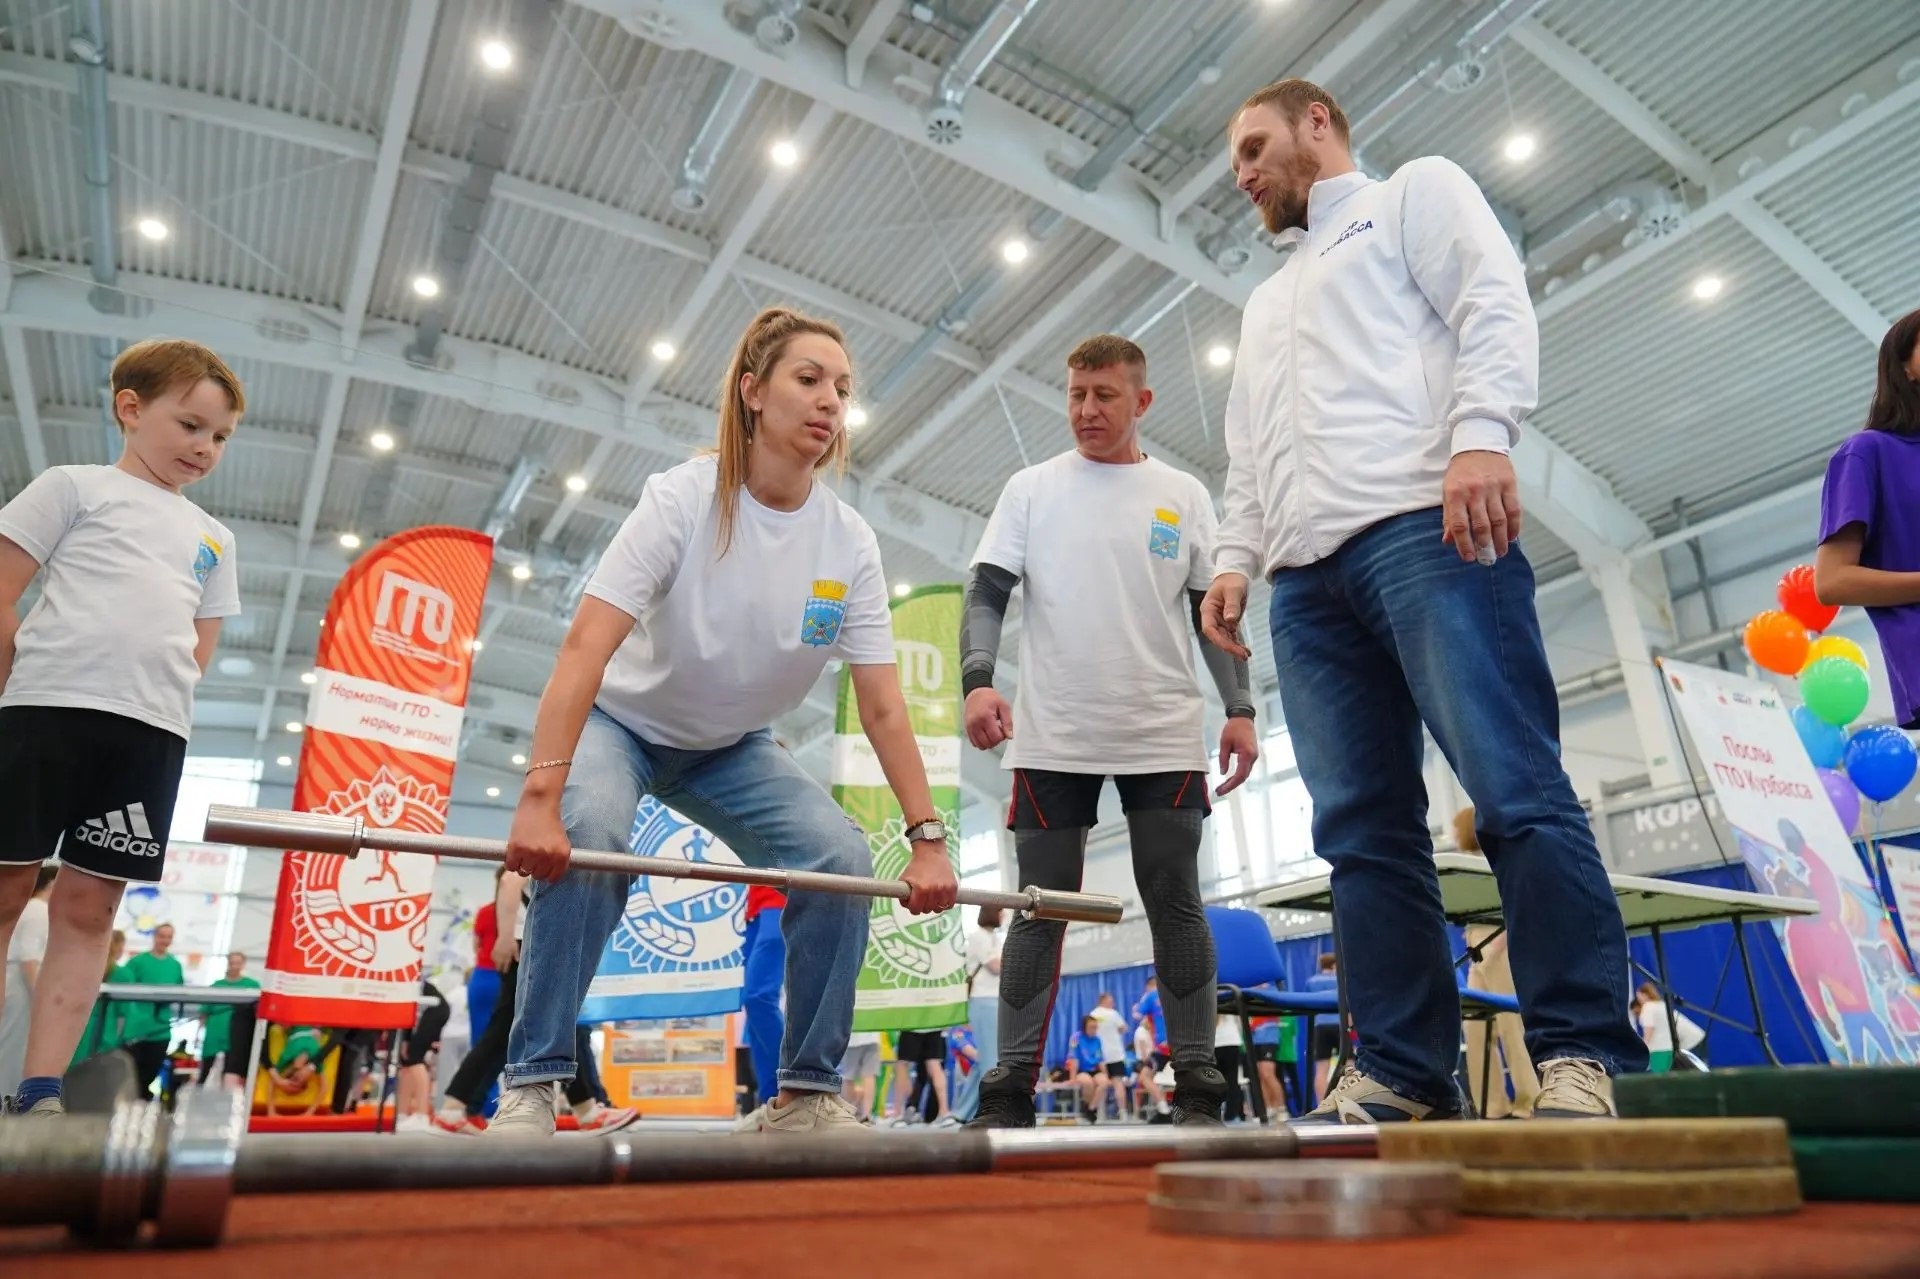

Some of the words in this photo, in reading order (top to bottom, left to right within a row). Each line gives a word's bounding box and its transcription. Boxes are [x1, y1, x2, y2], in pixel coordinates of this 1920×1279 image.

[374, 569, 454, 645] ГТО
[893, 640, 943, 691] ТО
[359, 715, 401, 735] норма
[400, 702, 431, 718] ГТО
[1722, 735, 1775, 765] Послы
[1713, 762, 1746, 789] ГТО
[1743, 767, 1813, 800] Кузбасса
[75, 825, 161, 858] adidas
[369, 898, 417, 927] ГТО
[681, 886, 736, 921] ГТО
[920, 914, 954, 942] ГТО
